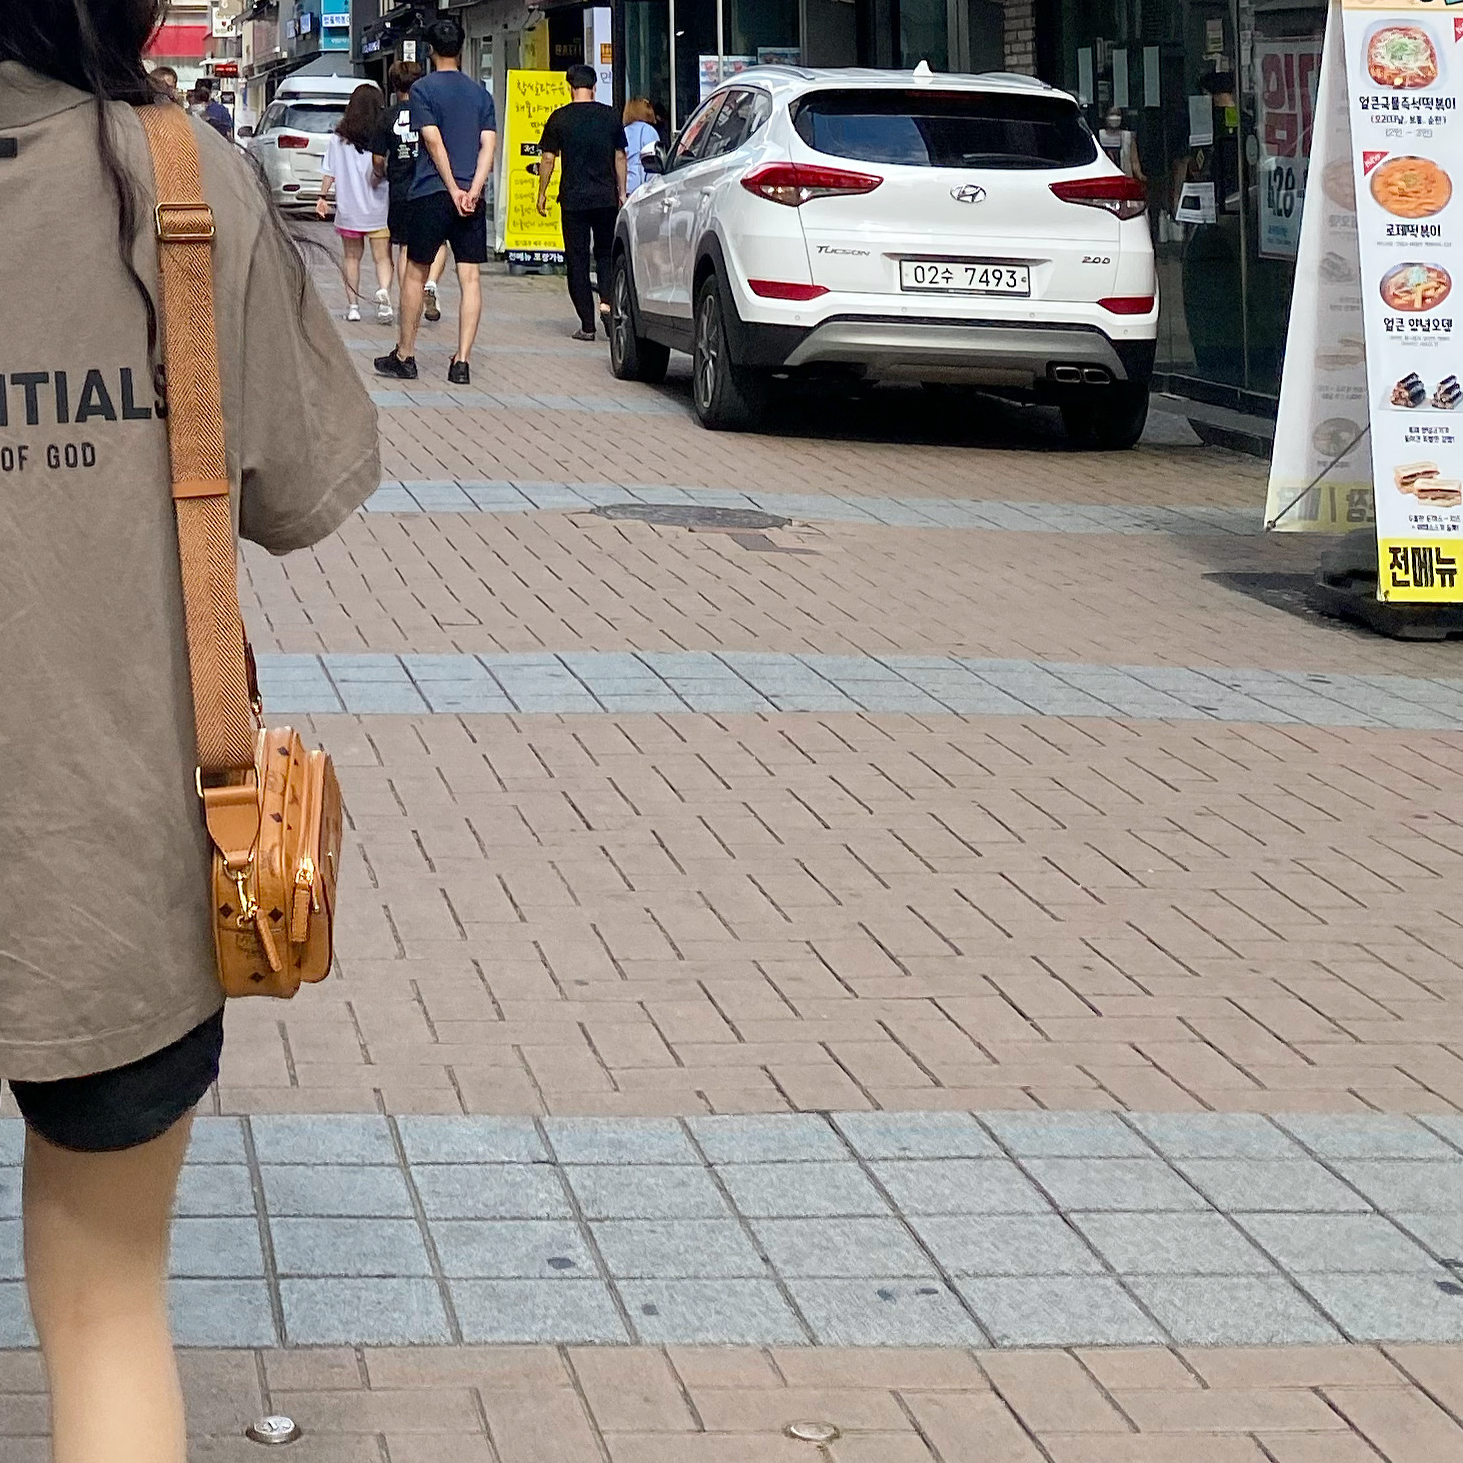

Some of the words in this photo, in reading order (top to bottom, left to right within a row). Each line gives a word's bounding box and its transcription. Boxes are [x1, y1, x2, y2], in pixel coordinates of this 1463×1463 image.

[914, 265, 954, 285] 02수
[965, 267, 1017, 288] 7493
[0, 445, 30, 473] OF
[47, 442, 97, 469] GOD
[1389, 546, 1458, 588] 전메뉴
